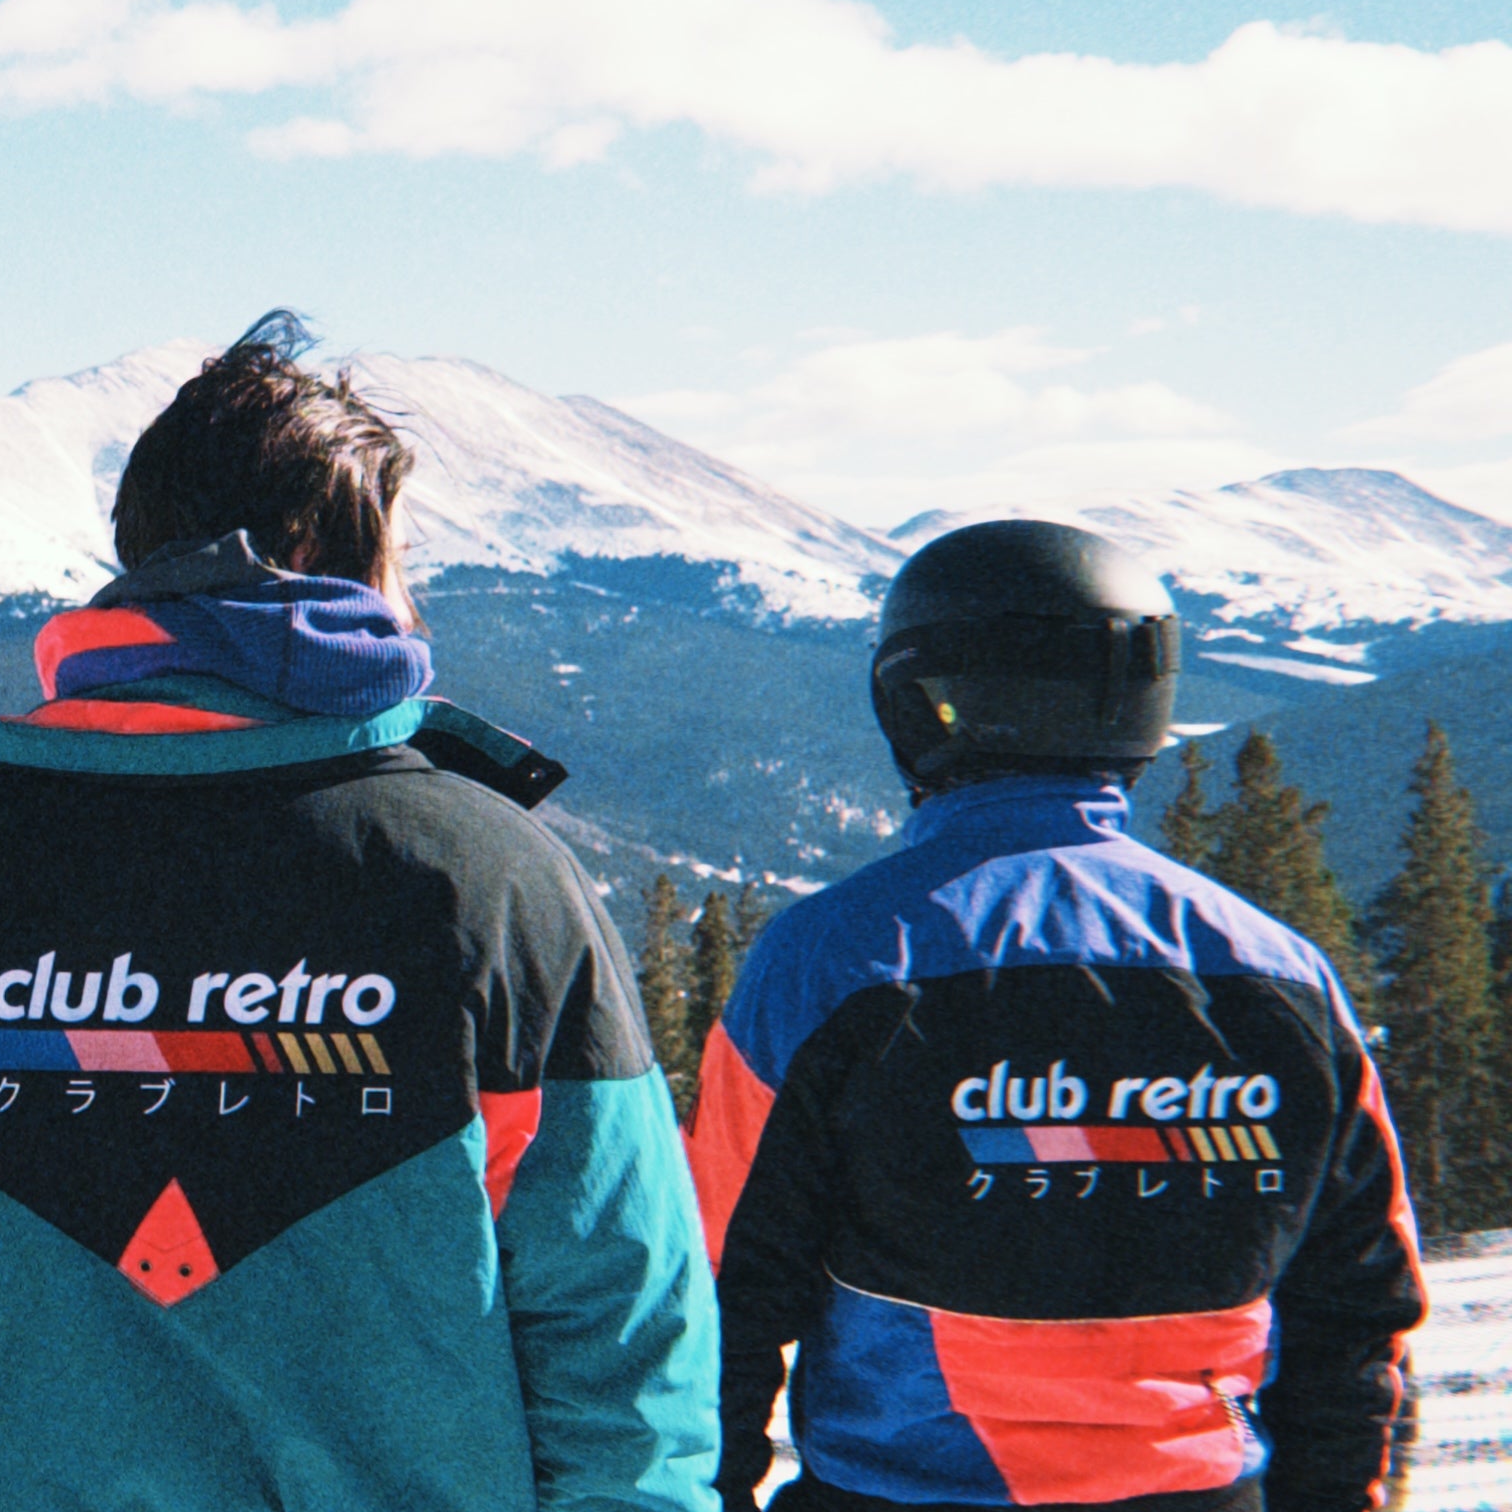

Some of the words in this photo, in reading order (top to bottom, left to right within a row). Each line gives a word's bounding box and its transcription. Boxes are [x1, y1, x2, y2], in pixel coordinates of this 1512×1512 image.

[186, 957, 396, 1026] retro
[950, 1058, 1089, 1121] club
[1107, 1062, 1281, 1120] retro
[965, 1166, 1286, 1200] クラブレトロ
